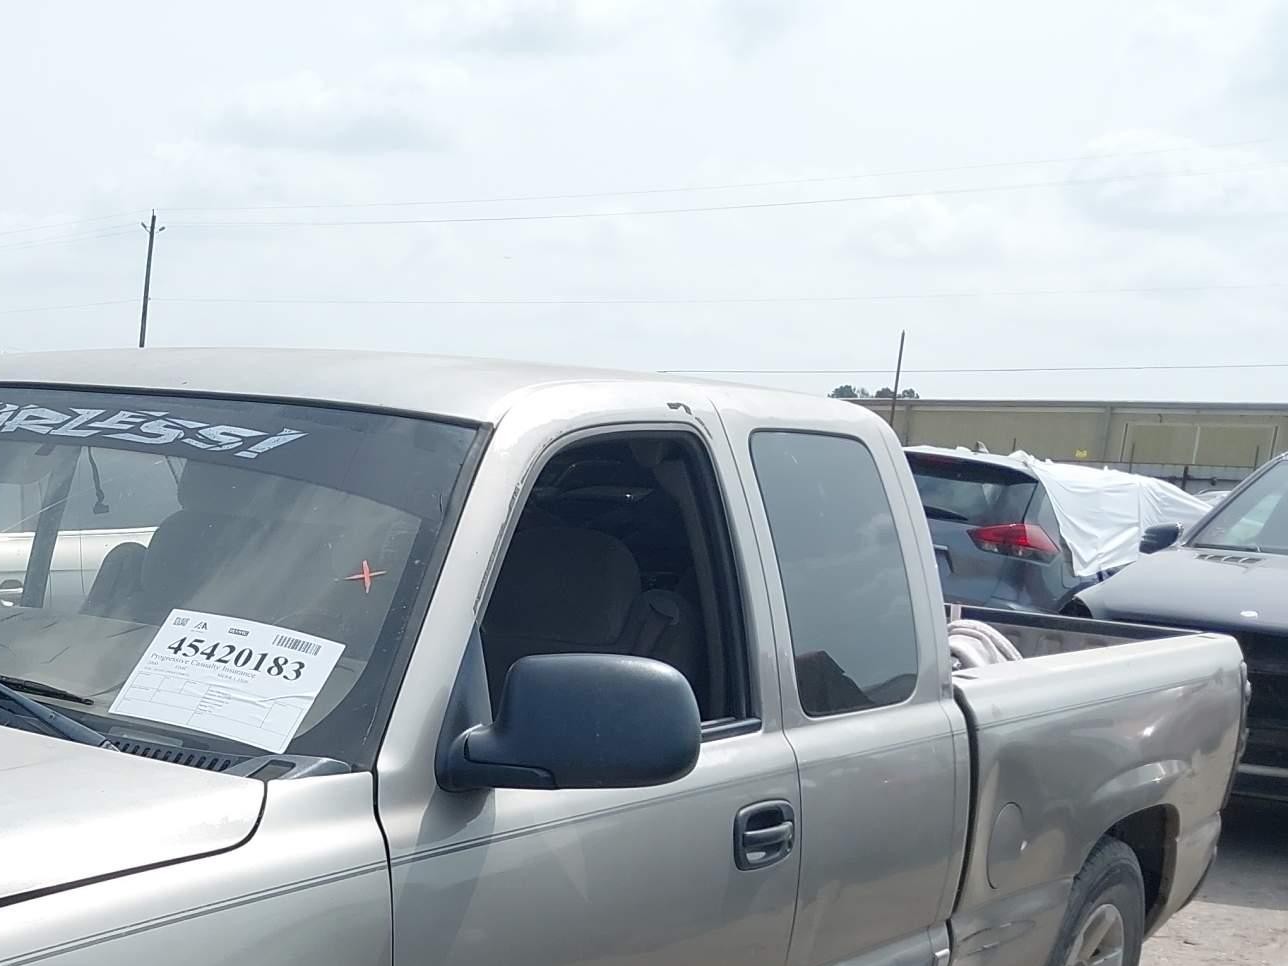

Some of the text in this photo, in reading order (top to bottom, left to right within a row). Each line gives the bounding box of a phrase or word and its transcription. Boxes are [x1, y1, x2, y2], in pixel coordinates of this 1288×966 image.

[150, 652, 190, 665] Progressive
[191, 660, 221, 671] Casualty
[222, 664, 257, 679] Insurance
[168, 637, 305, 682] 45420183
